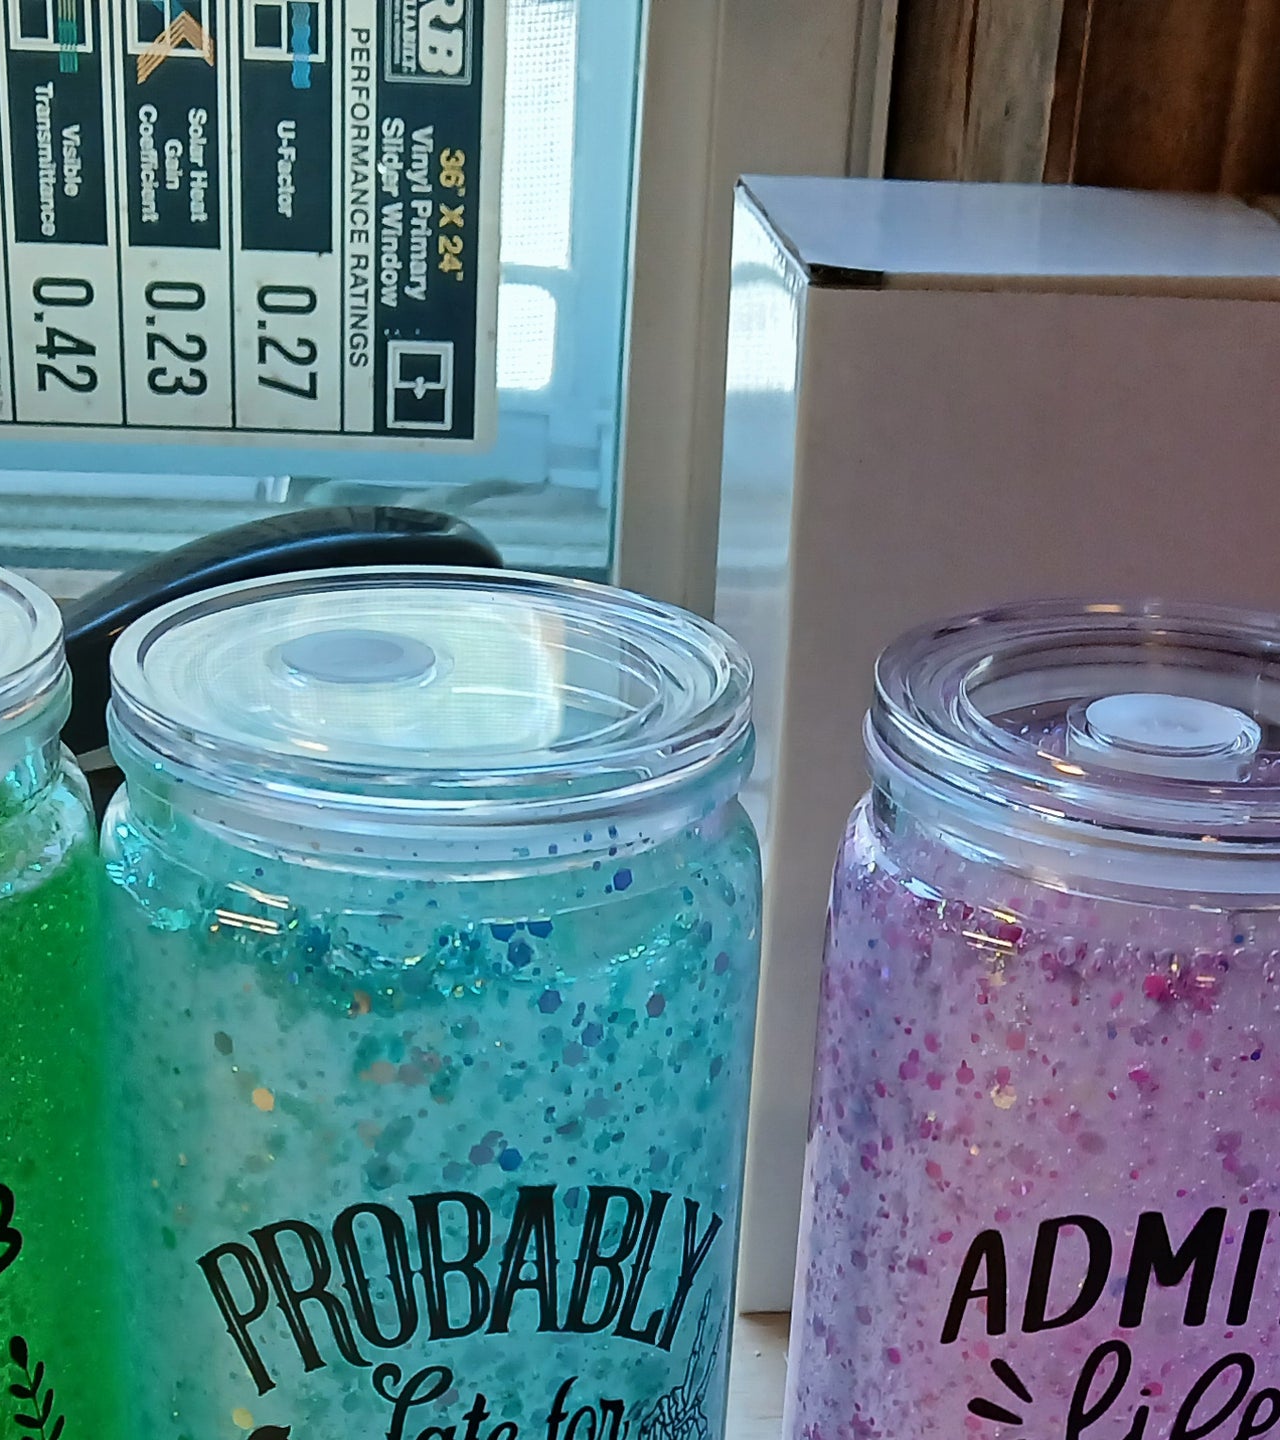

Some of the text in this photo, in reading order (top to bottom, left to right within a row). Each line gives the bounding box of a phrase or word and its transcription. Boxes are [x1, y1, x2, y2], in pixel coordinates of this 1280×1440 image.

[33, 82, 56, 236] Transmittance
[60, 124, 81, 197] Visible
[138, 104, 158, 222] Coefficient
[164, 139, 183, 189] Gain
[188, 108, 207, 222] Solar Heat
[276, 120, 295, 217] U-Factor
[348, 28, 370, 367] PERFORMANCE RATINGS
[377, 117, 404, 307] Slider Window
[404, 125, 433, 300] Vinyl Primary
[439, 203, 464, 228] X
[31, 277, 97, 394] 0.42
[144, 281, 206, 396] 0.23
[257, 286, 317, 400] 0.27
[196, 1184, 723, 1396] PROBABLY
